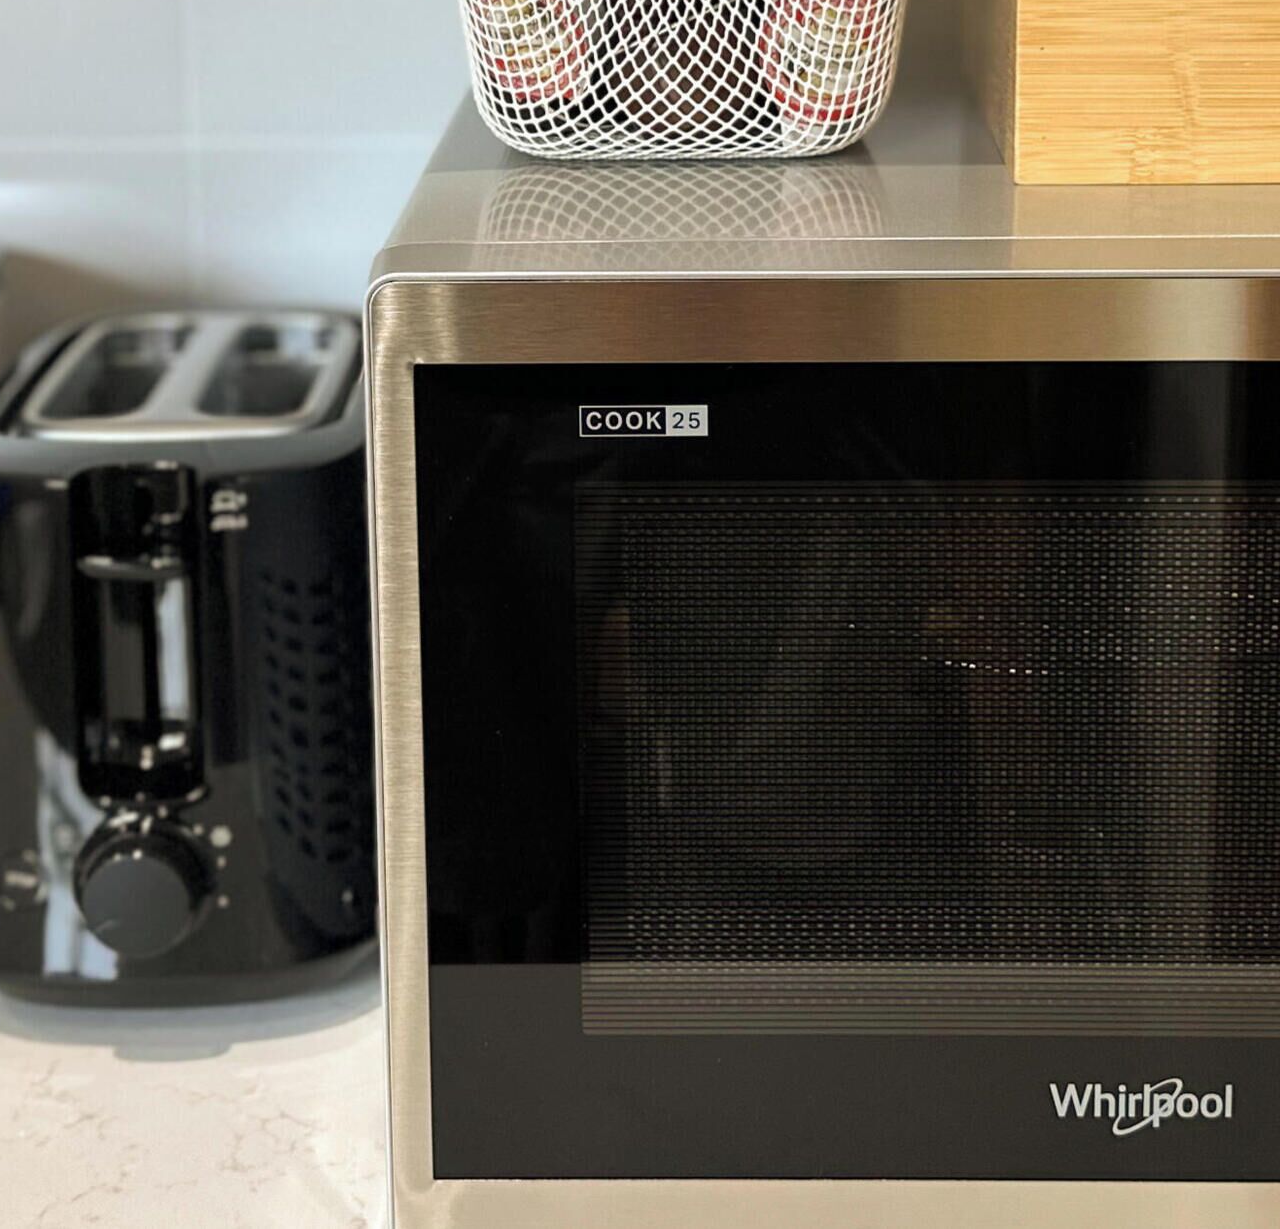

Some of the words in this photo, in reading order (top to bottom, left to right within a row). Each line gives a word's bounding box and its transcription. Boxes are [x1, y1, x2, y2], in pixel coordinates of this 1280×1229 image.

[585, 411, 663, 431] COOK
[671, 411, 701, 430] 25
[1048, 1081, 1234, 1130] Whirlpool
